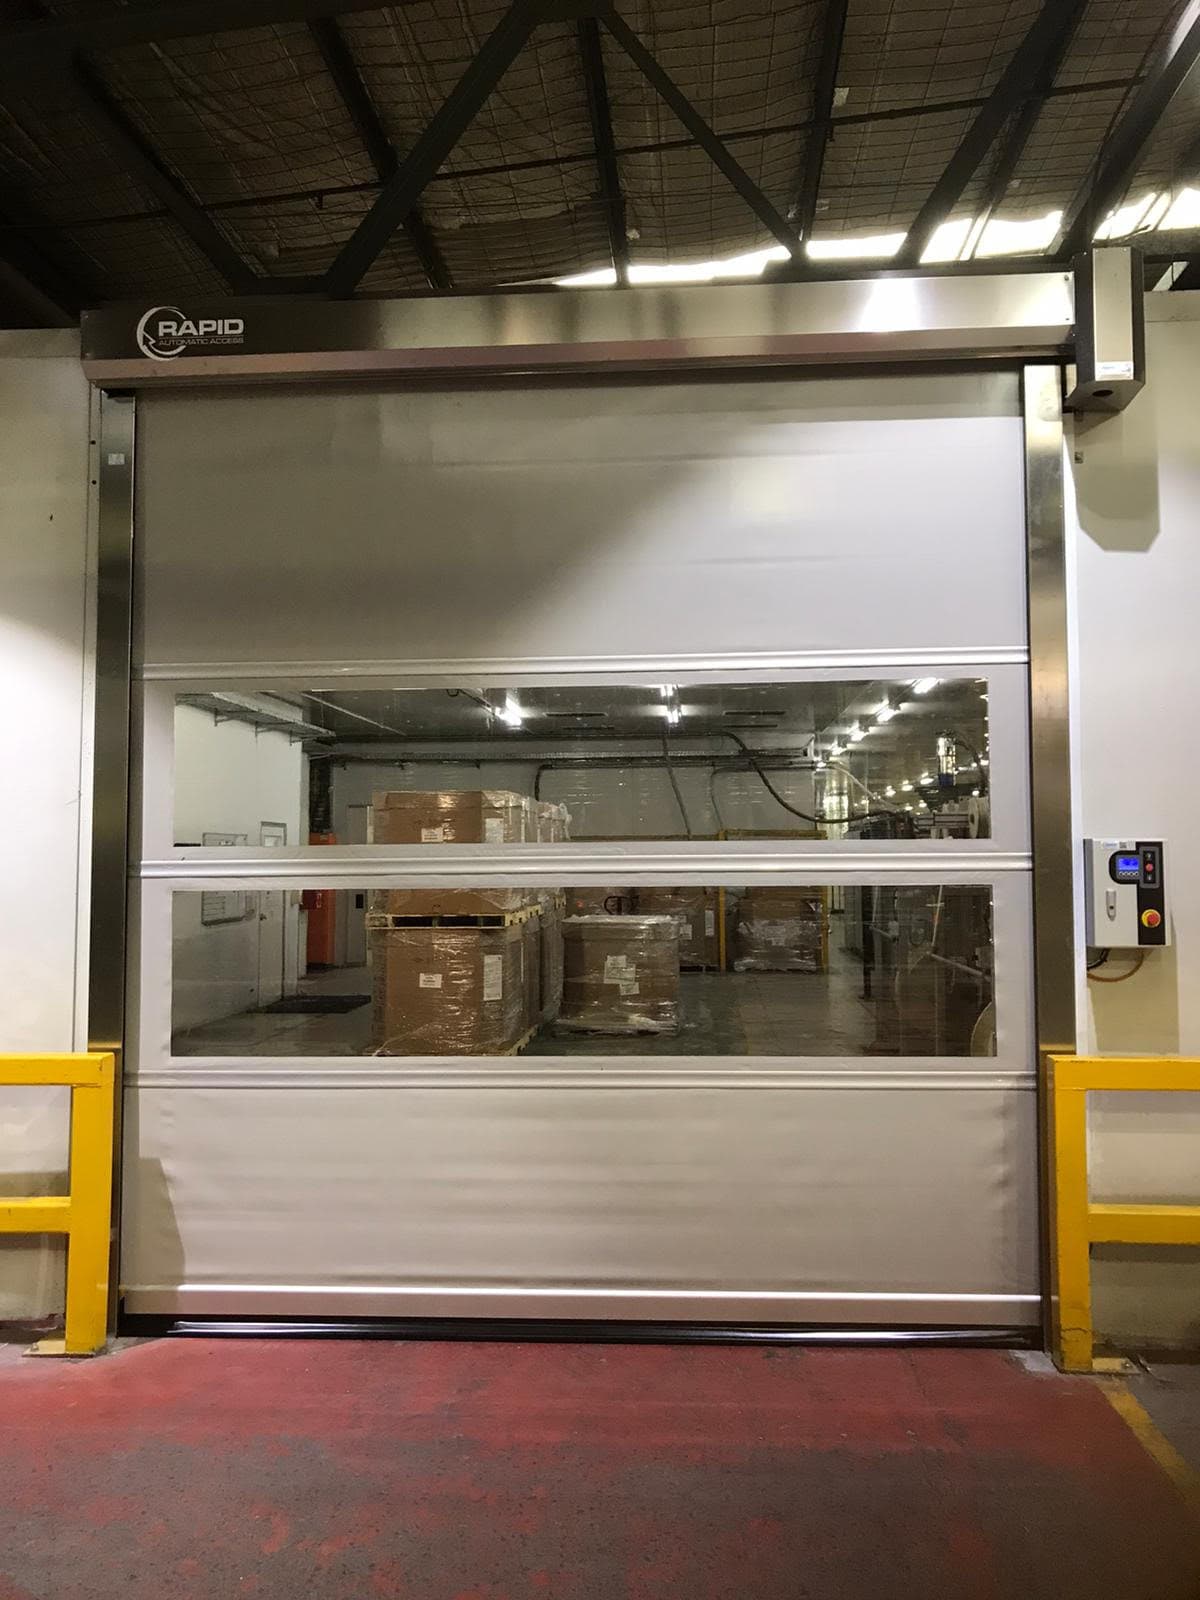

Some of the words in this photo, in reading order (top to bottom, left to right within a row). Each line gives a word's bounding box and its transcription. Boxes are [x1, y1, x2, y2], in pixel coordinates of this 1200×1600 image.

[158, 319, 244, 337] RAPID
[158, 338, 208, 346] AUTOMATIC
[210, 337, 244, 345] ACCESS
